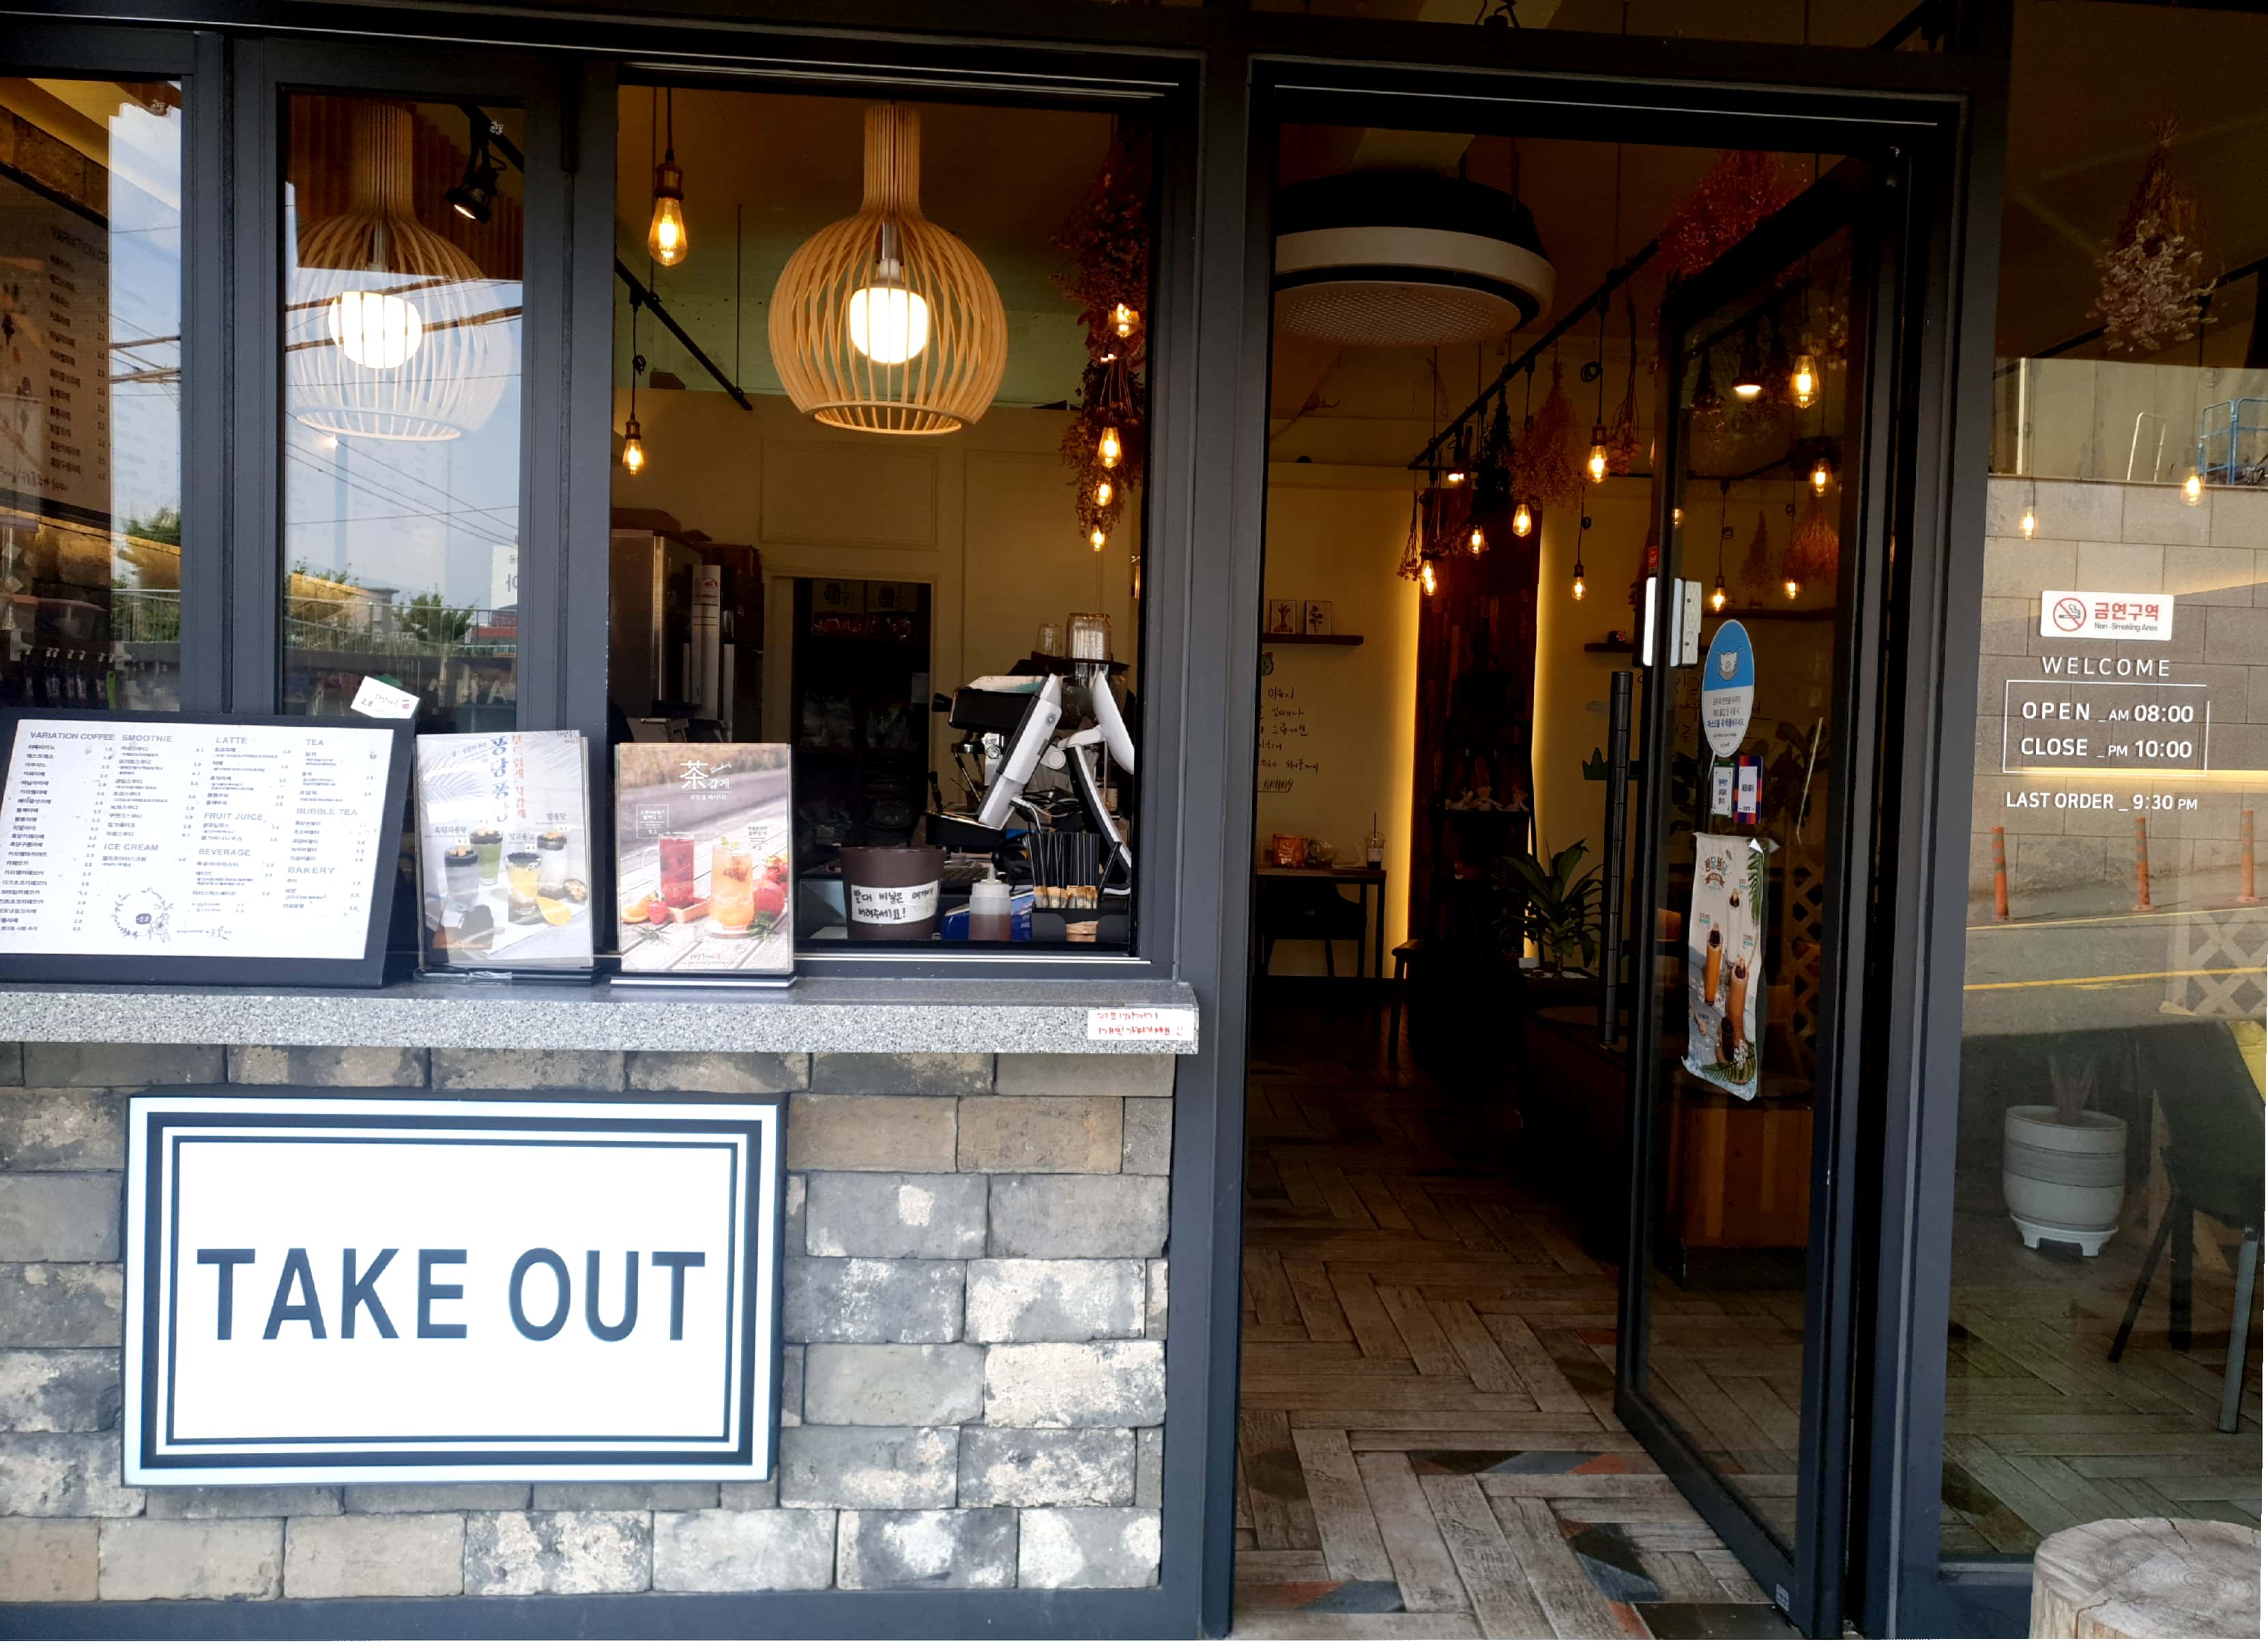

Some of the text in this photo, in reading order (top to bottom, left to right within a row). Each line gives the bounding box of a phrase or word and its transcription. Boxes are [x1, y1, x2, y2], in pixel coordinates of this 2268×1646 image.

[2094, 602, 2160, 622] 금연구역
[2142, 624, 2158, 632] Area
[2041, 656, 2170, 677] WELCOME
[2022, 702, 2090, 721] OPEN
[2134, 705, 2194, 723] 08:00
[31, 732, 78, 740] VARIATION
[2021, 738, 2088, 757] CLOSE
[2135, 740, 2192, 759] 10:00
[2006, 792, 2050, 809] LAST
[2055, 793, 2114, 809] ORDER
[2133, 794, 2173, 811] 9:30
[2178, 798, 2198, 811] PM
[199, 848, 251, 856] BEVERAGE
[288, 866, 335, 874] BAKERY
[197, 1247, 706, 1342] TAKE OUT
